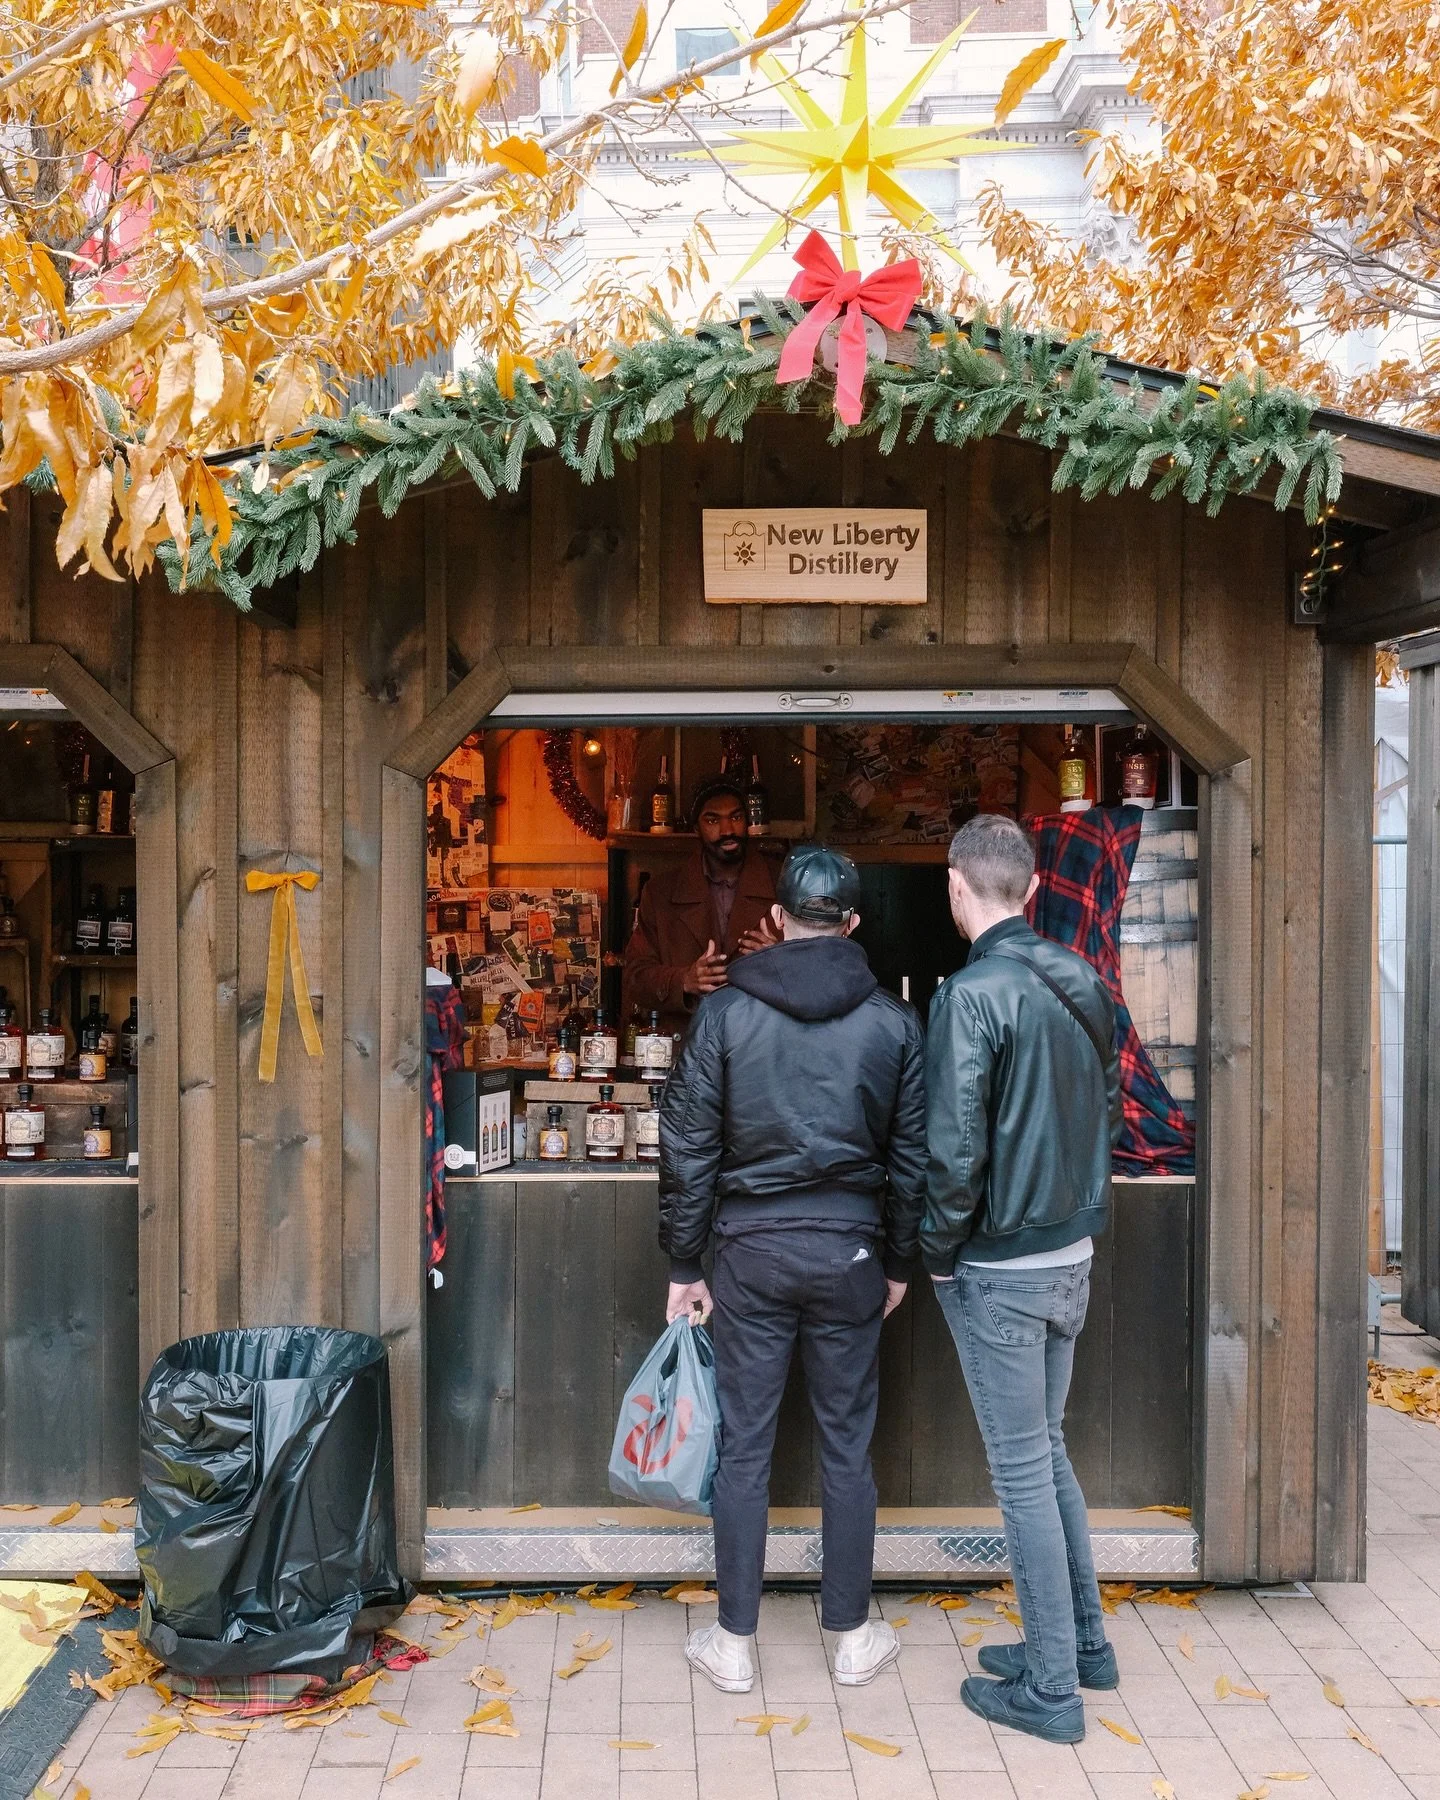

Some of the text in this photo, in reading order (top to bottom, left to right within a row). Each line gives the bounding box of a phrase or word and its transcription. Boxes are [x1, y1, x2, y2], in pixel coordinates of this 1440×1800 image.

[767, 521, 920, 551] New Liberty
[788, 551, 899, 580] Distillery
